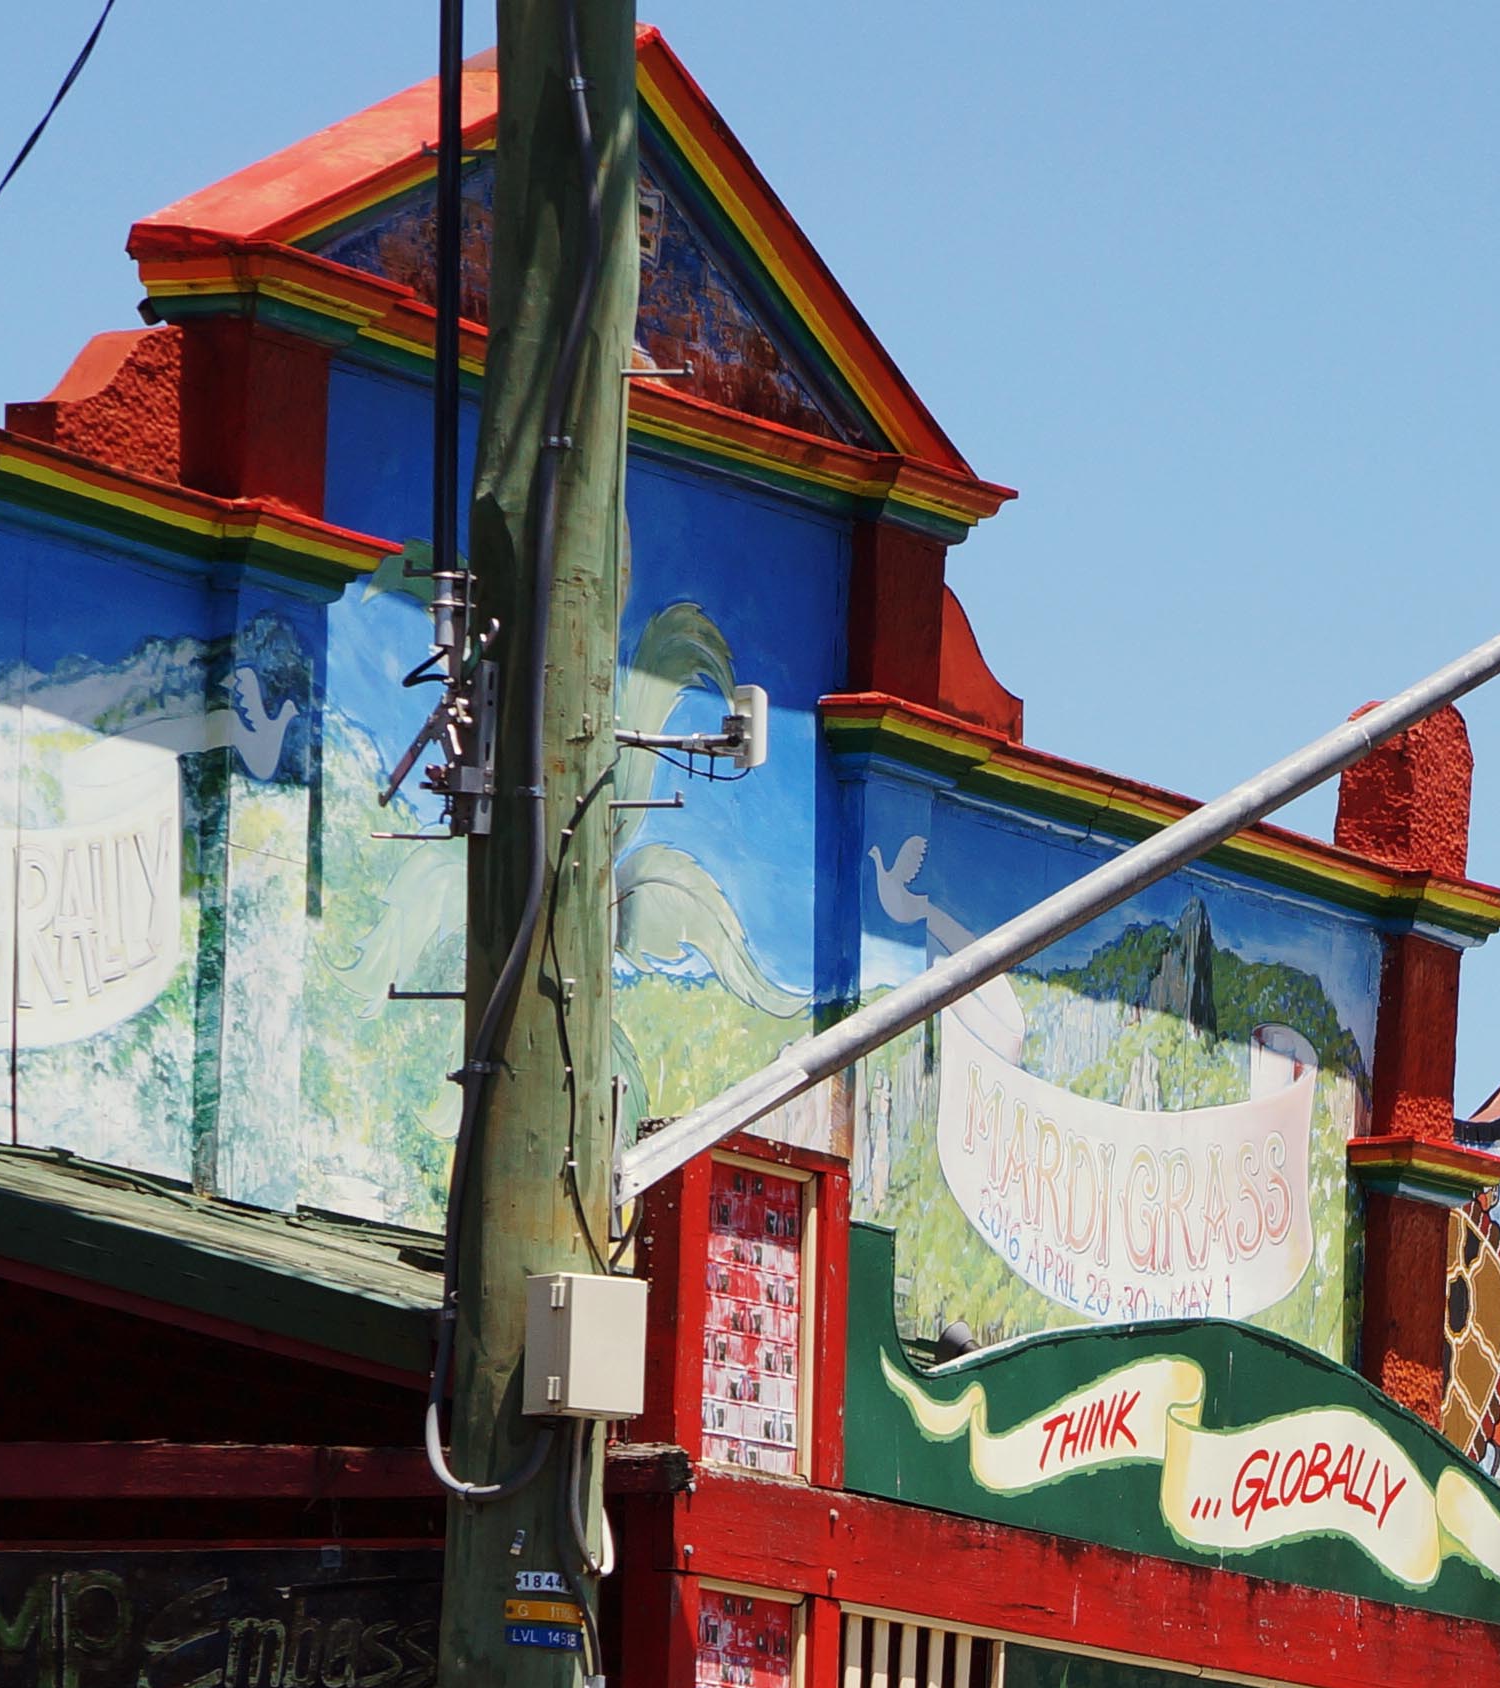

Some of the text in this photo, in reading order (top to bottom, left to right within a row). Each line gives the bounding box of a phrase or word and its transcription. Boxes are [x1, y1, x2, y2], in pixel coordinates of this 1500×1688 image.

[963, 1061, 1293, 1275] MARDI GRASS
[1025, 1237, 1079, 1305] APRIL
[1169, 1278, 1213, 1320] MAY
[1039, 1390, 1138, 1471] THINK
[512, 1629, 540, 1643] LVL
[518, 1604, 529, 1617] G
